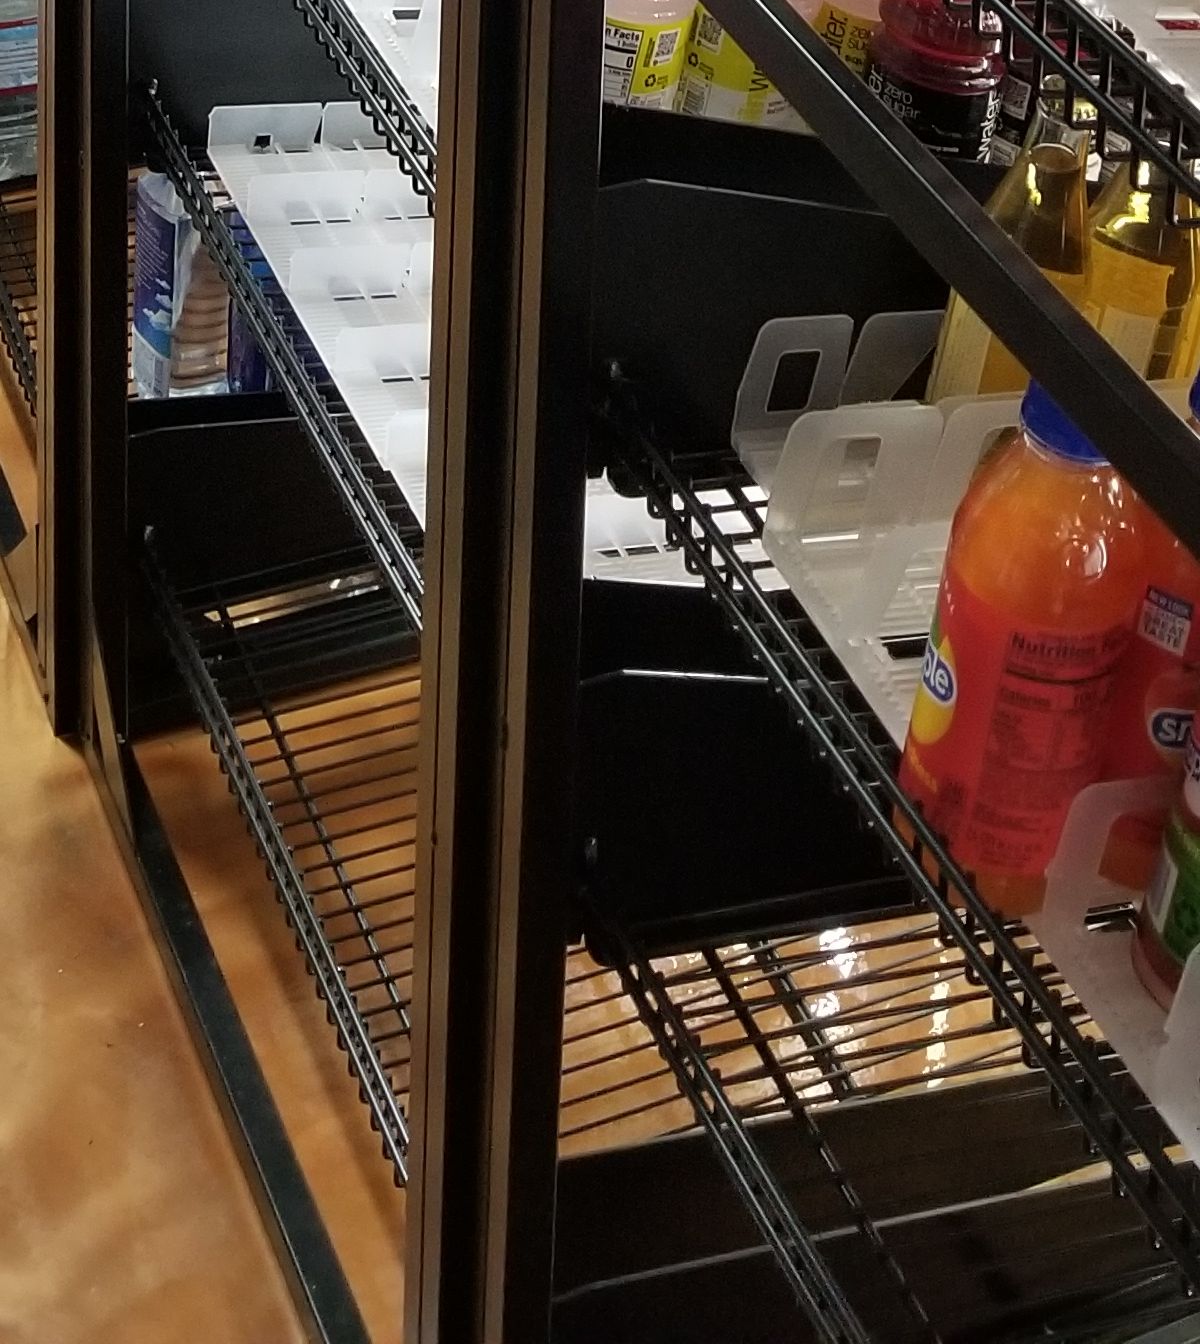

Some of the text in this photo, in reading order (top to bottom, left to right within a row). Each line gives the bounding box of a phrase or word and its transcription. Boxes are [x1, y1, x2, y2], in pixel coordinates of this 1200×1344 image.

[613, 28, 641, 42] Facts
[626, 55, 634, 69] 0
[883, 80, 914, 105] zero
